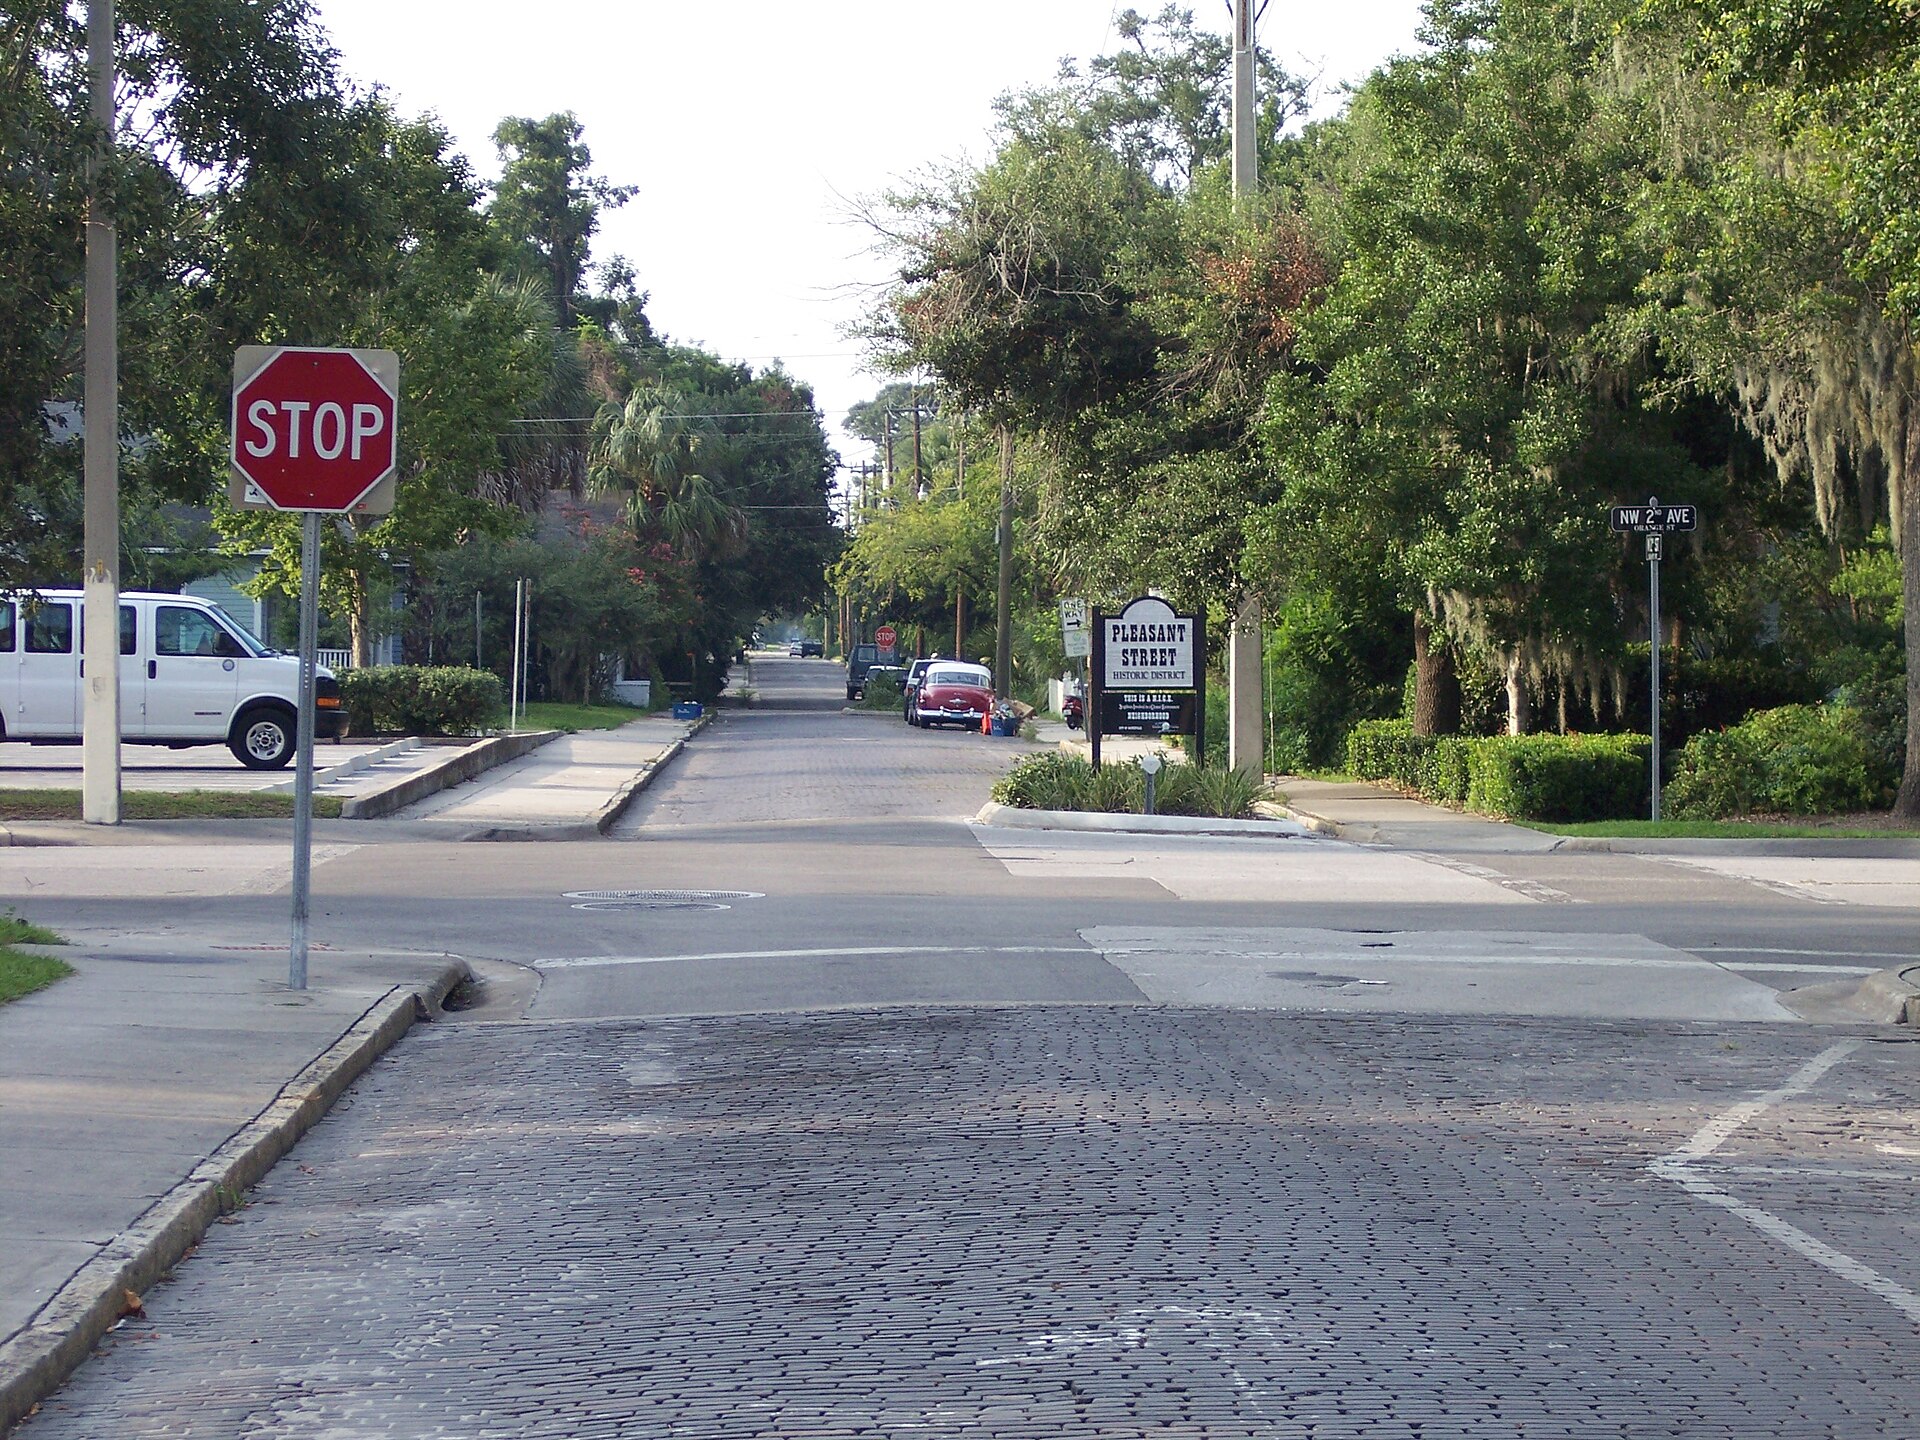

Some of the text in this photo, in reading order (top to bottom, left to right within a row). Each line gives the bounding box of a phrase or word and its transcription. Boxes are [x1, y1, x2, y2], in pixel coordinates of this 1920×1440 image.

[244, 399, 385, 460] STOP
[1620, 510, 1640, 524] NW
[1667, 509, 1690, 523] AVE
[1063, 599, 1083, 609] ONE
[1064, 609, 1083, 618] WAY
[877, 632, 894, 641] STOP
[1112, 624, 1186, 642] PLEASANT
[1122, 648, 1177, 666] STREET
[1113, 671, 1186, 680] HISTORIC DISTRICT
